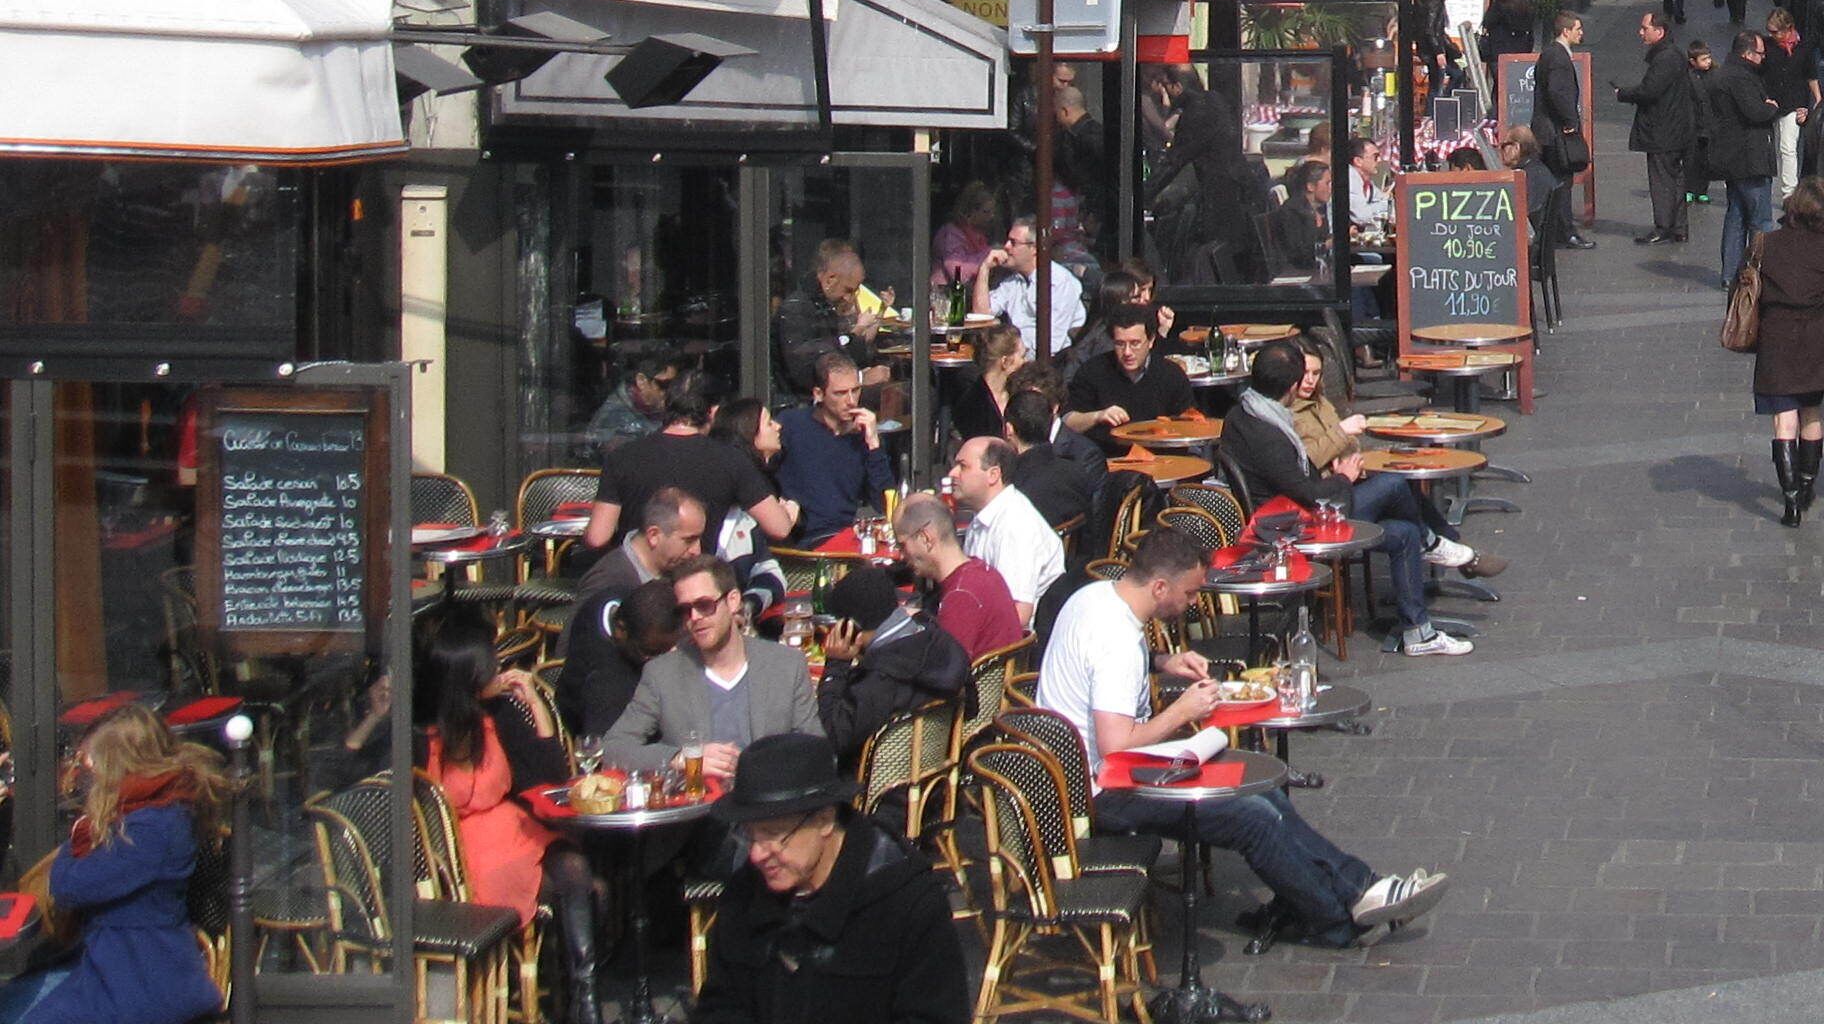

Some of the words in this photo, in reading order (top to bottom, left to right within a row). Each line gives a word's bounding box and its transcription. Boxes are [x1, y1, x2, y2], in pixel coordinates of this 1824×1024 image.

[1415, 188, 1514, 222] PIZZA
[1431, 222, 1457, 235] DU
[1466, 223, 1504, 240] JOUR
[1443, 238, 1497, 260] 10,90€
[1409, 266, 1460, 292] PLATS
[1464, 270, 1487, 292] DU
[223, 471, 274, 491] Salade
[223, 492, 277, 509] Salade
